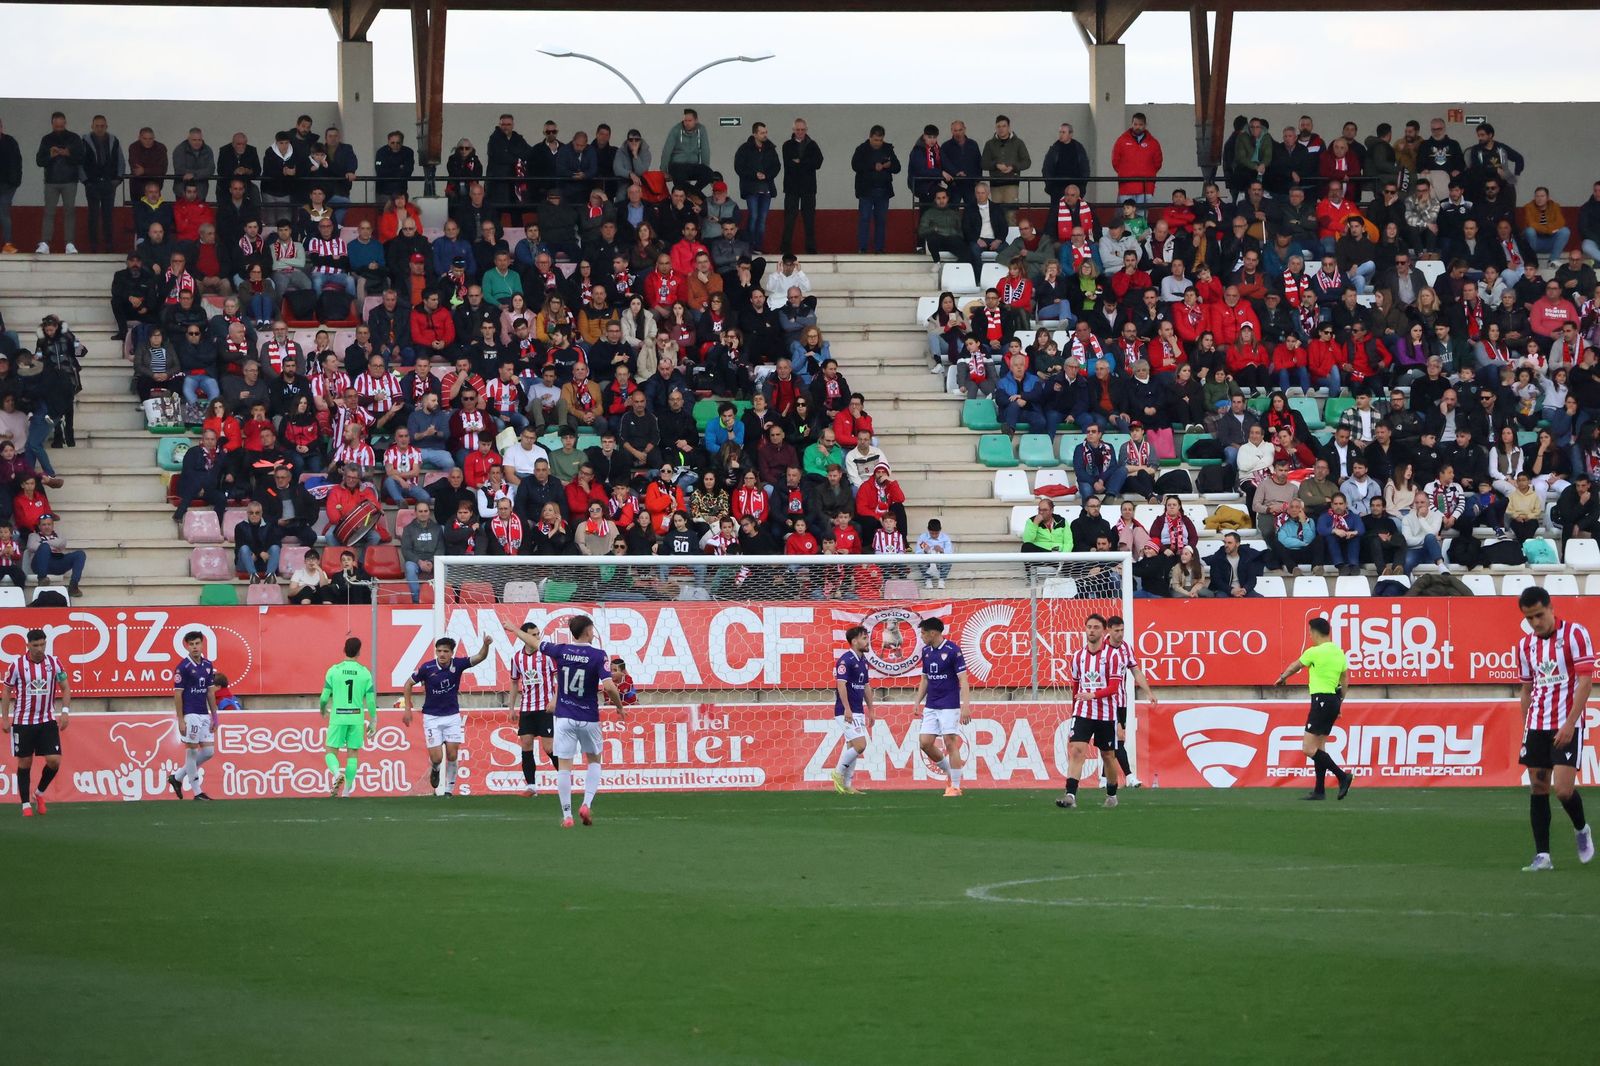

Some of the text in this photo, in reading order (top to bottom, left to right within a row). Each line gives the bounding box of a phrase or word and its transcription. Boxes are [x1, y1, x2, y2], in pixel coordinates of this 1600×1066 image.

[875, 610, 911, 620] FONDO
[1330, 603, 1437, 651] fisio
[709, 607, 814, 684] CF
[1138, 622, 1267, 655] ÓPTICO
[562, 653, 591, 664] TAVARES
[869, 654, 920, 672] MODORRO
[1343, 640, 1455, 677] eadapt
[561, 666, 586, 697] 14
[1350, 669, 1418, 678] LICLÍNICA
[1489, 670, 1518, 679] PODOL
[345, 679, 354, 704] 1
[191, 725, 198, 733] 10
[428, 729, 433, 738] 3
[1266, 724, 1484, 766] FRIMAY
